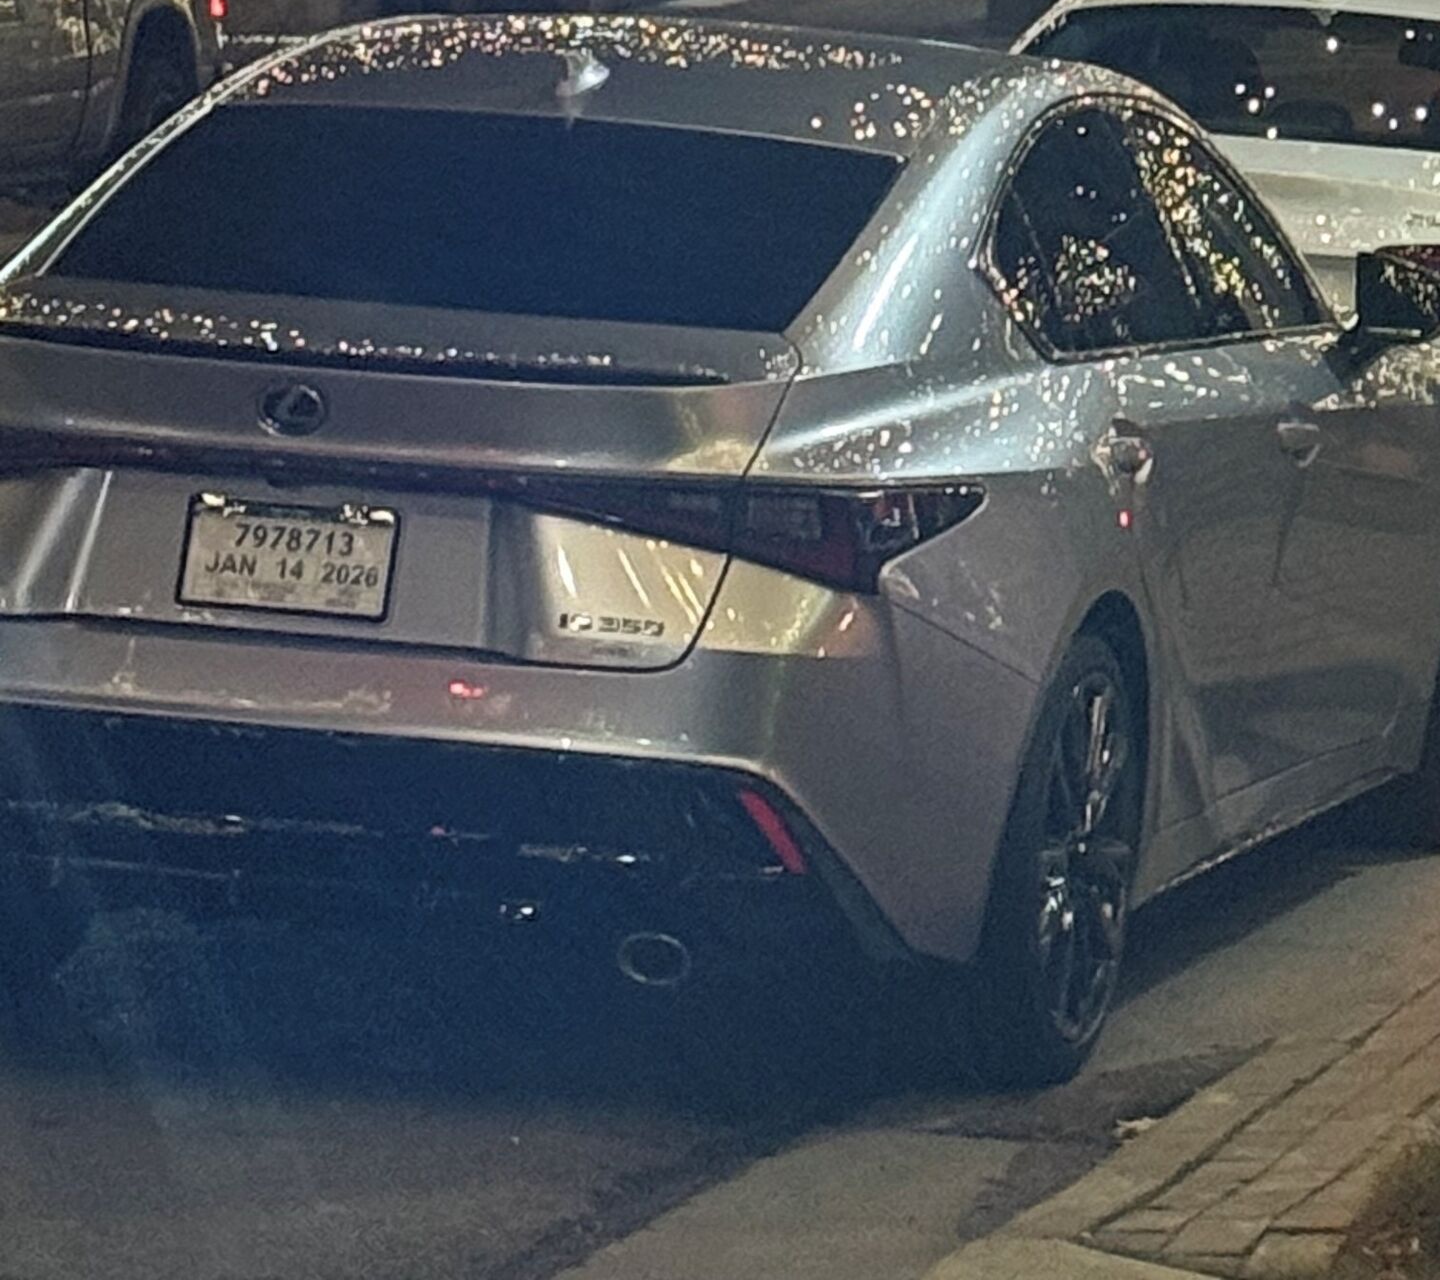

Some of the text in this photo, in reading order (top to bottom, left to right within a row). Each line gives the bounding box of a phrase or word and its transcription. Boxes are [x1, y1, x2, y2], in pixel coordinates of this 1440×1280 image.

[234, 523, 355, 558] 7978713
[205, 551, 380, 589] JAN 14 2026
